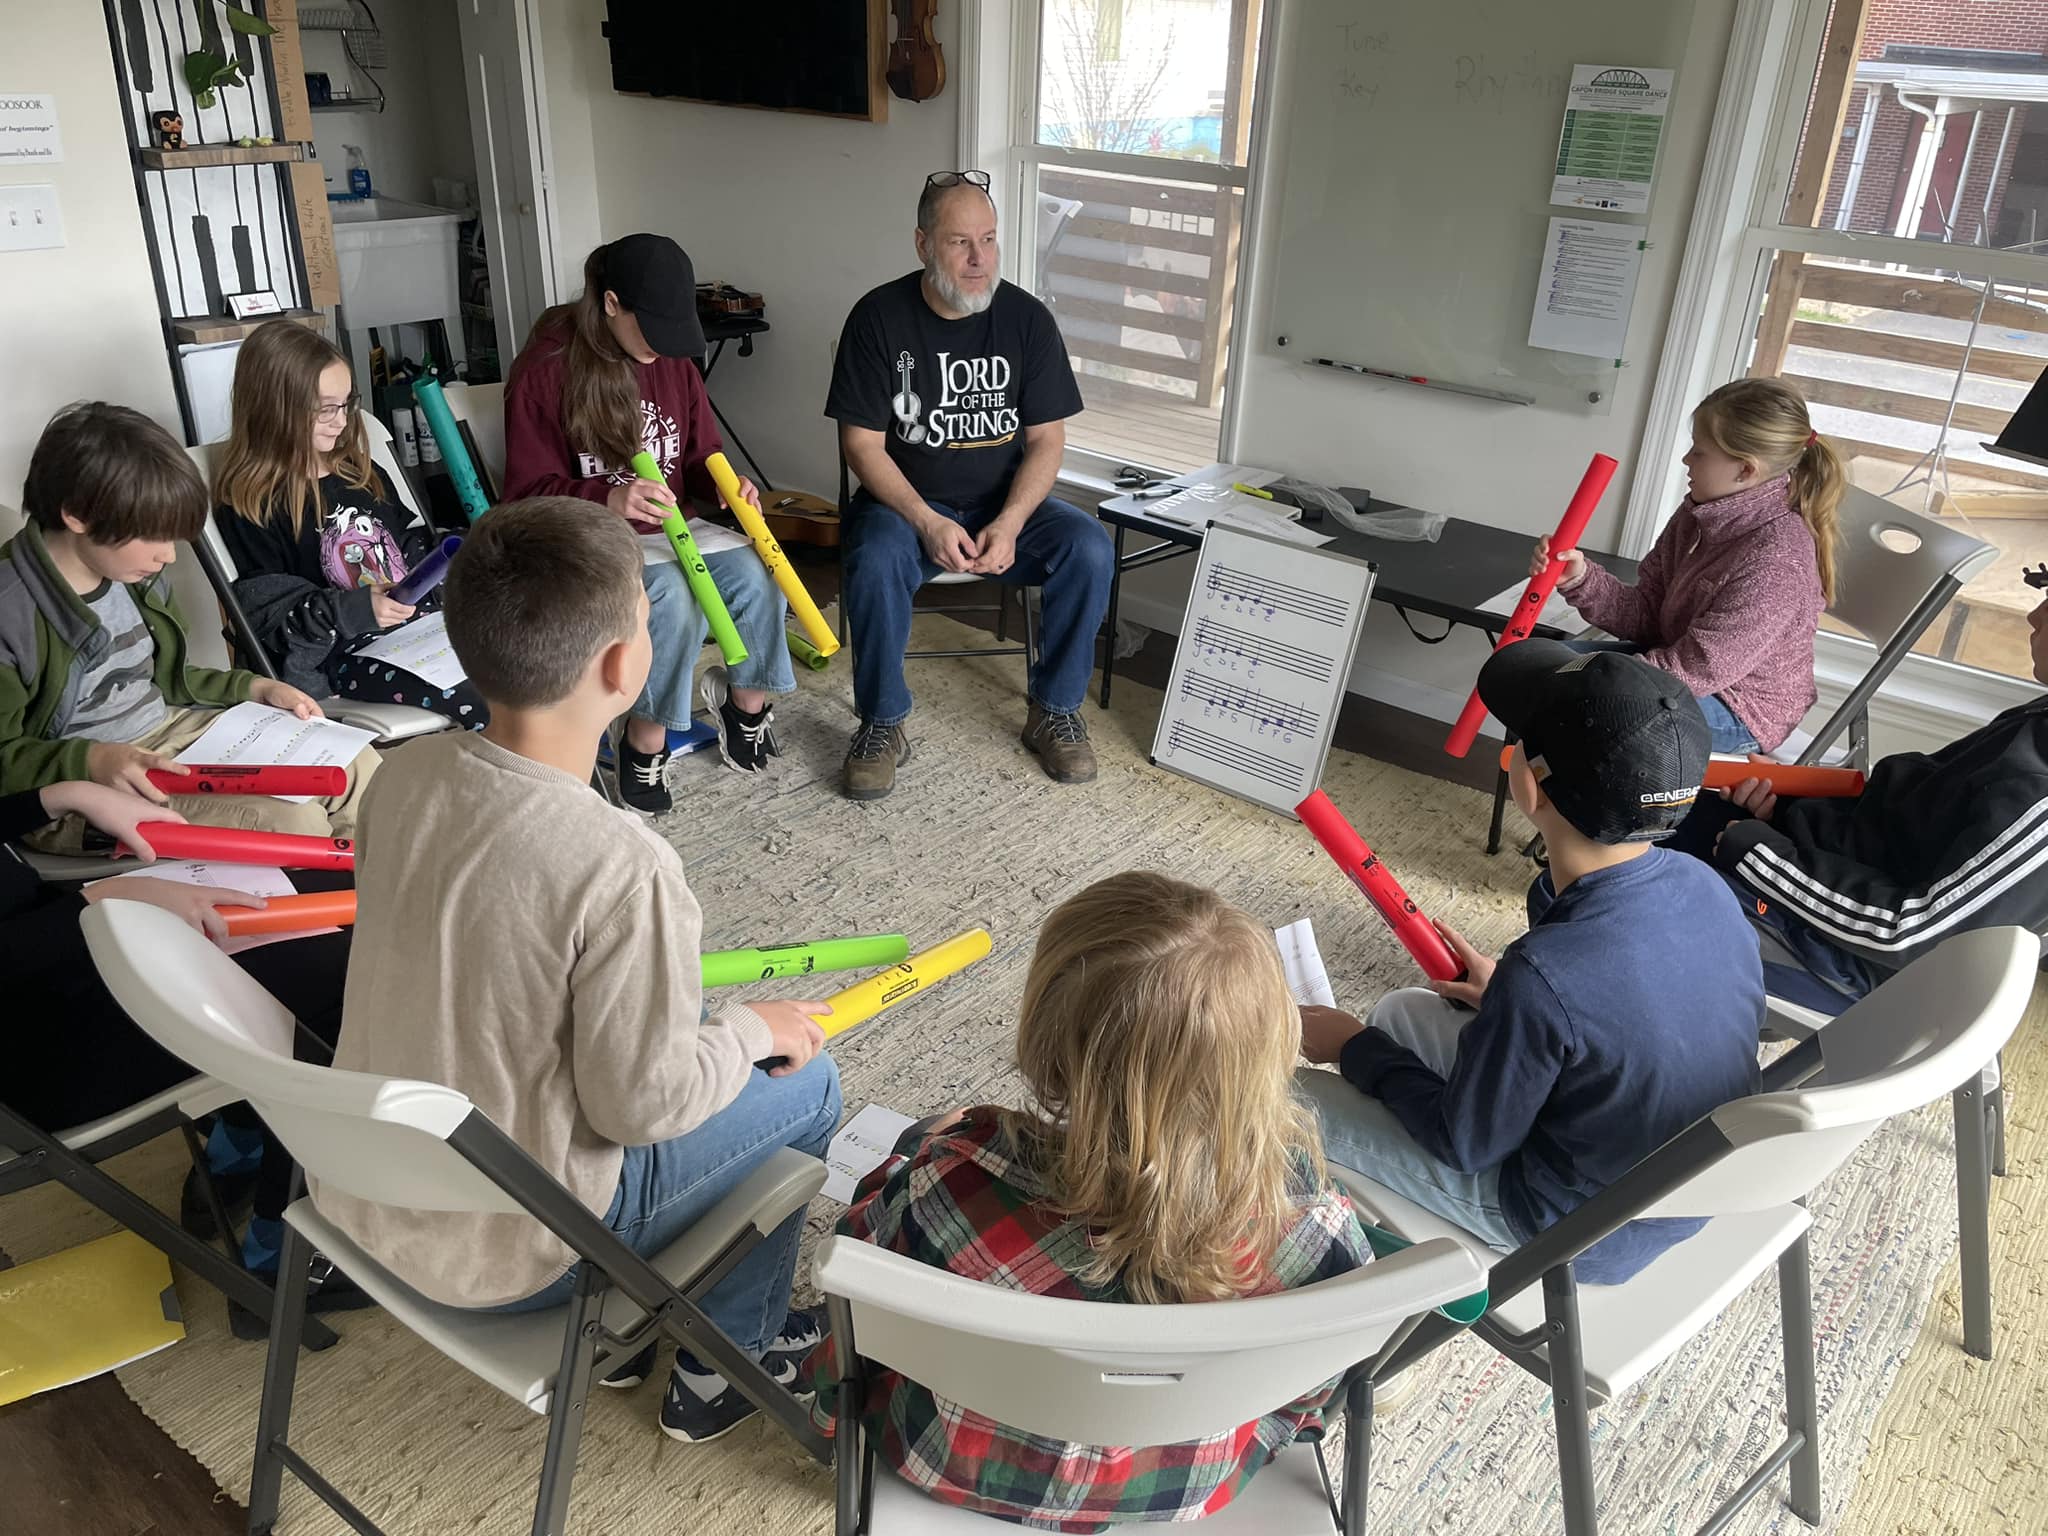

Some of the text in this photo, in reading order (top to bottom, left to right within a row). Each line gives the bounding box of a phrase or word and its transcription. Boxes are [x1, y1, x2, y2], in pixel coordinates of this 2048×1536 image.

[936, 352, 1011, 407] LORD
[961, 392, 1006, 410] OF THE
[925, 407, 1020, 448] STRINGS
[1640, 785, 1701, 802] GENERA
